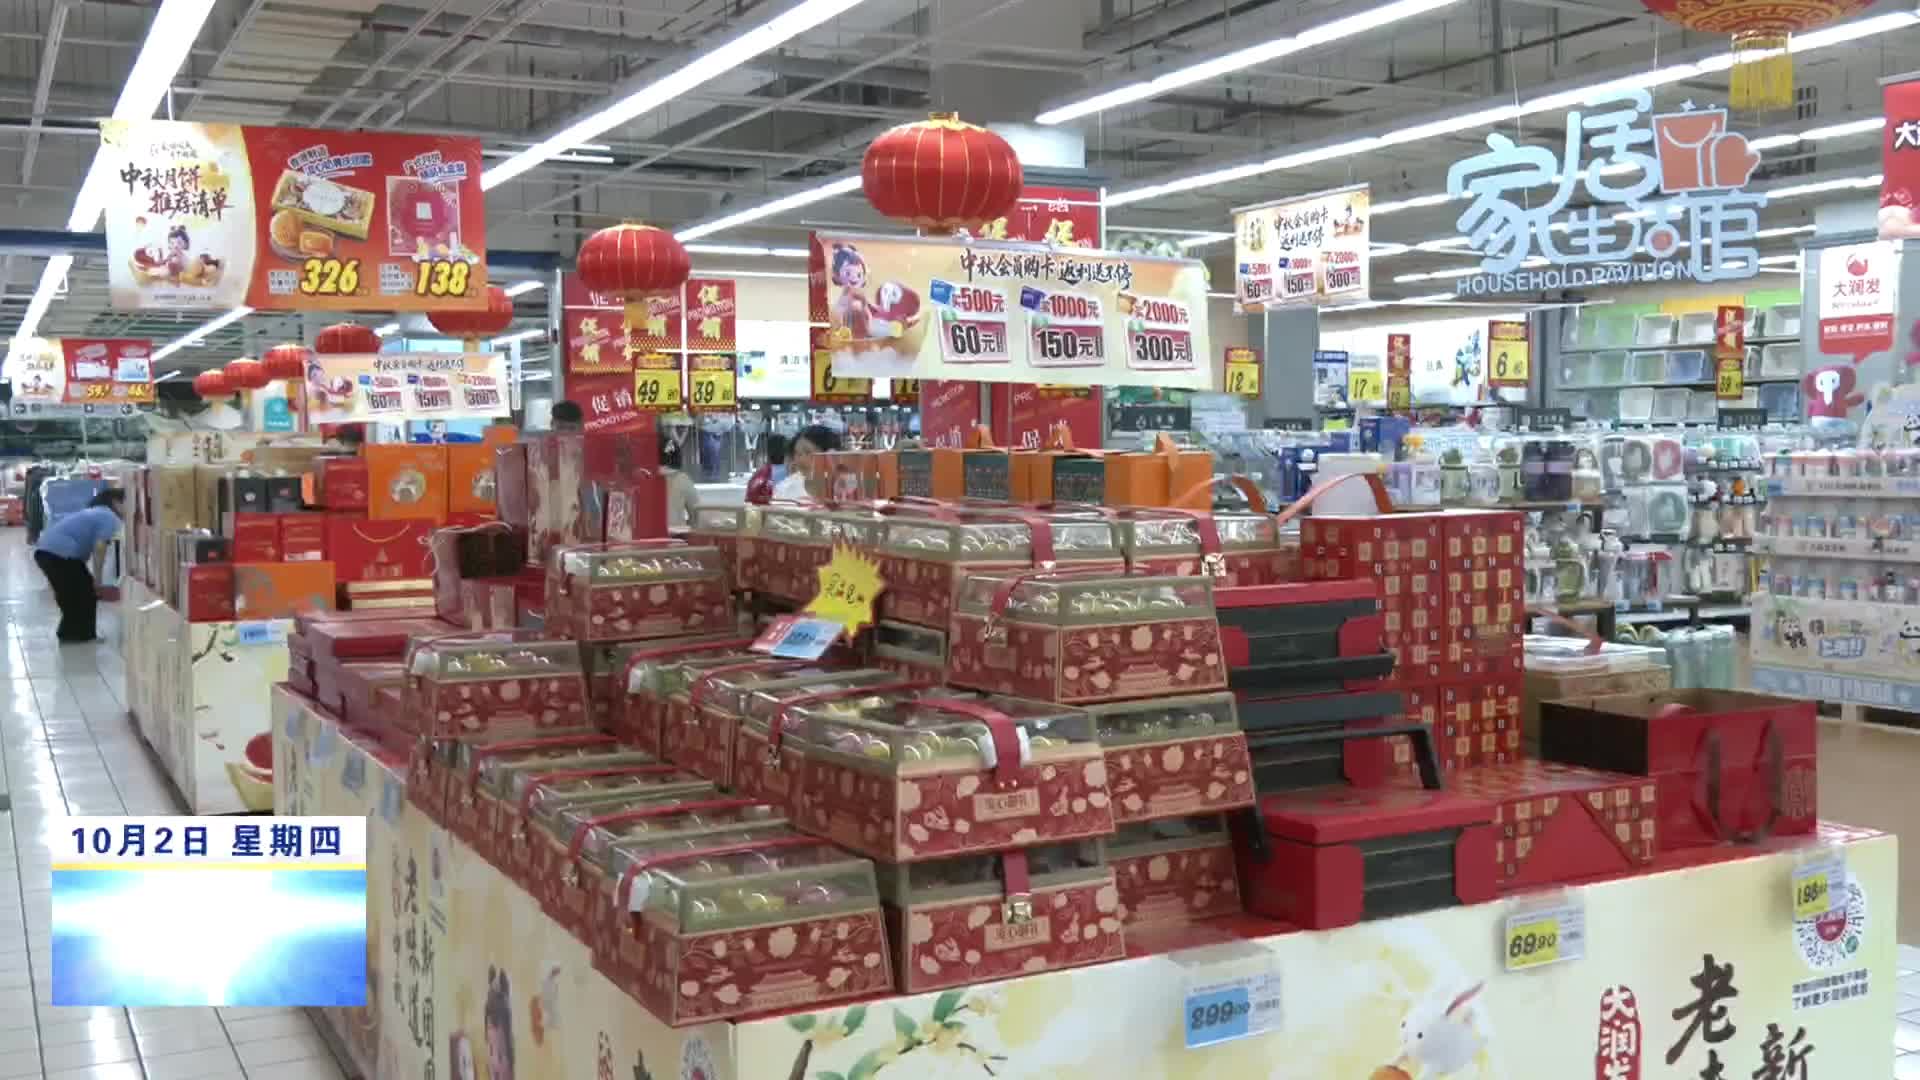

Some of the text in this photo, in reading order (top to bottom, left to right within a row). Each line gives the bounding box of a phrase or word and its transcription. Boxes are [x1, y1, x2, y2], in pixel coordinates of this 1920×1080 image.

[1894, 120, 1920, 150] 大
[120, 162, 203, 196] 中秋月饼
[148, 188, 234, 222] 推荐清单
[301, 258, 359, 294] 326
[416, 261, 469, 295] 138
[960, 248, 1133, 290] 中秋会员购卡 返利送不停
[1456, 259, 1695, 295] HOUSEHOLD PAVILION
[1832, 277, 1880, 297] 大润发
[638, 379, 660, 402] 49
[1509, 932, 1557, 957] 69.90
[1666, 953, 1739, 1080] 老
